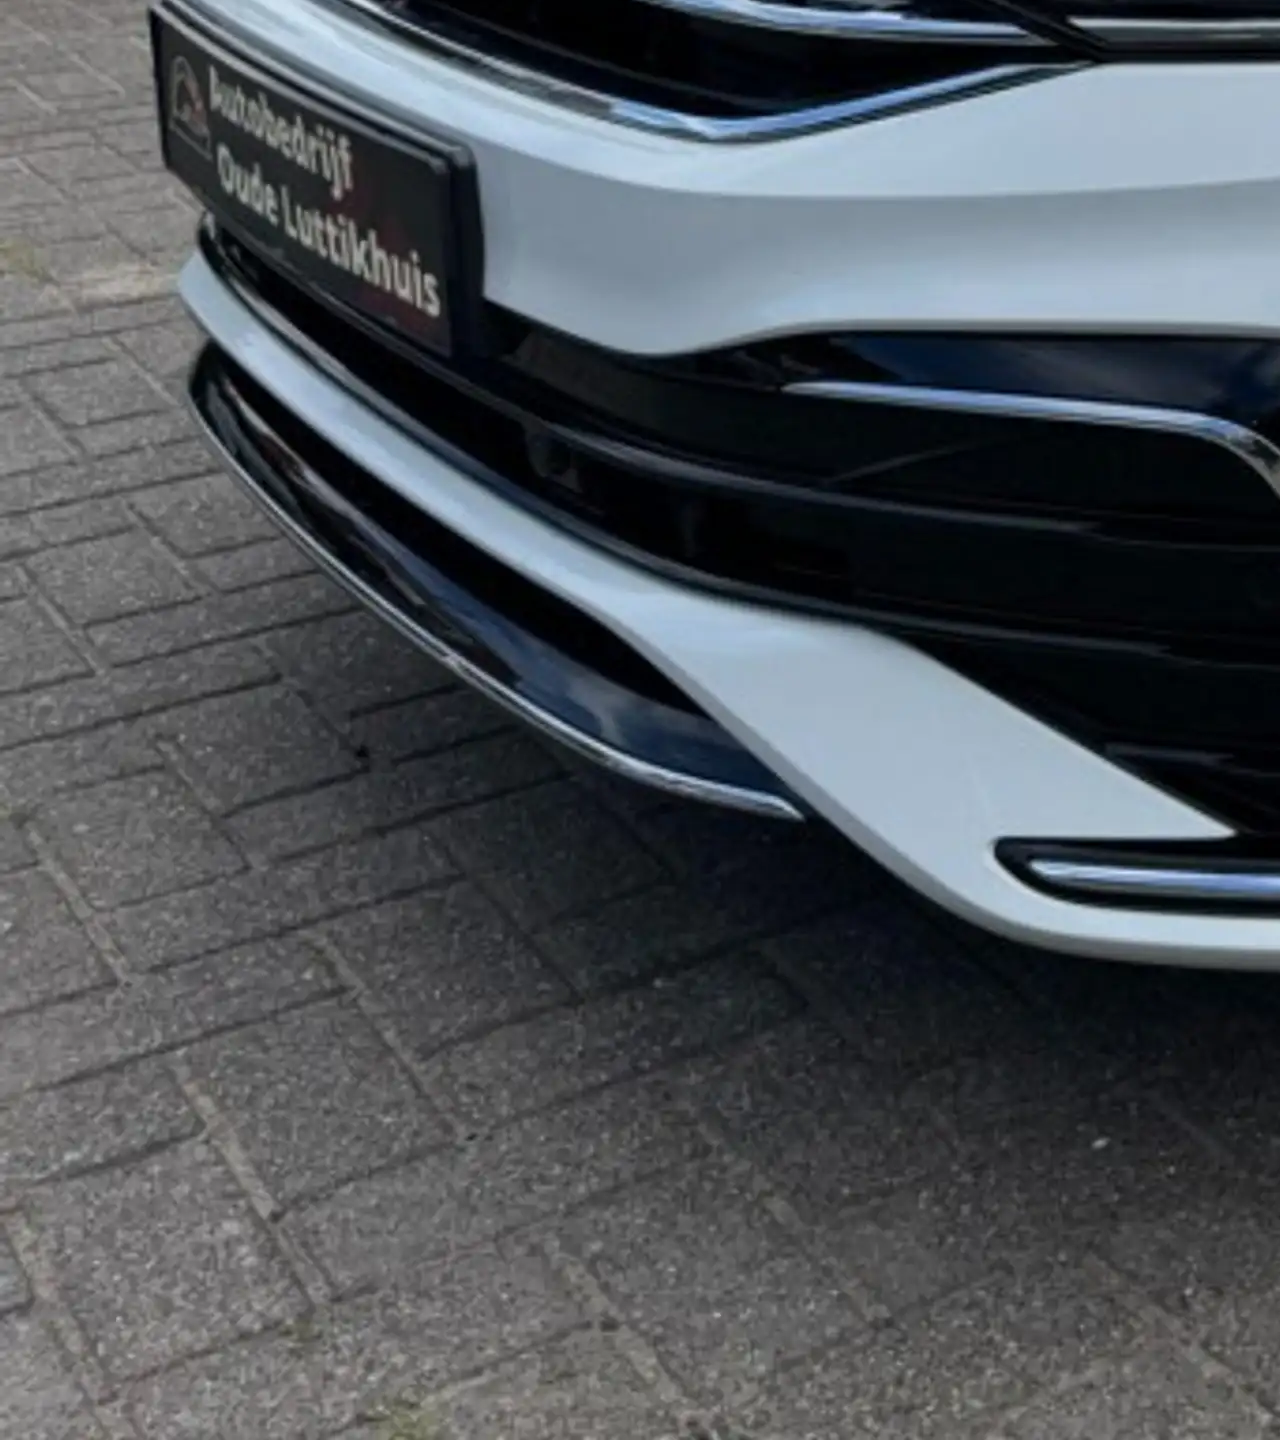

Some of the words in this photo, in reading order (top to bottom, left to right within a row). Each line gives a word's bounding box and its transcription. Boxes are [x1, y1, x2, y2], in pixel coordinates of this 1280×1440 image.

[209, 64, 354, 201] Autobedrijf
[217, 142, 279, 227] Oude
[281, 184, 441, 318] Luttikhuis
